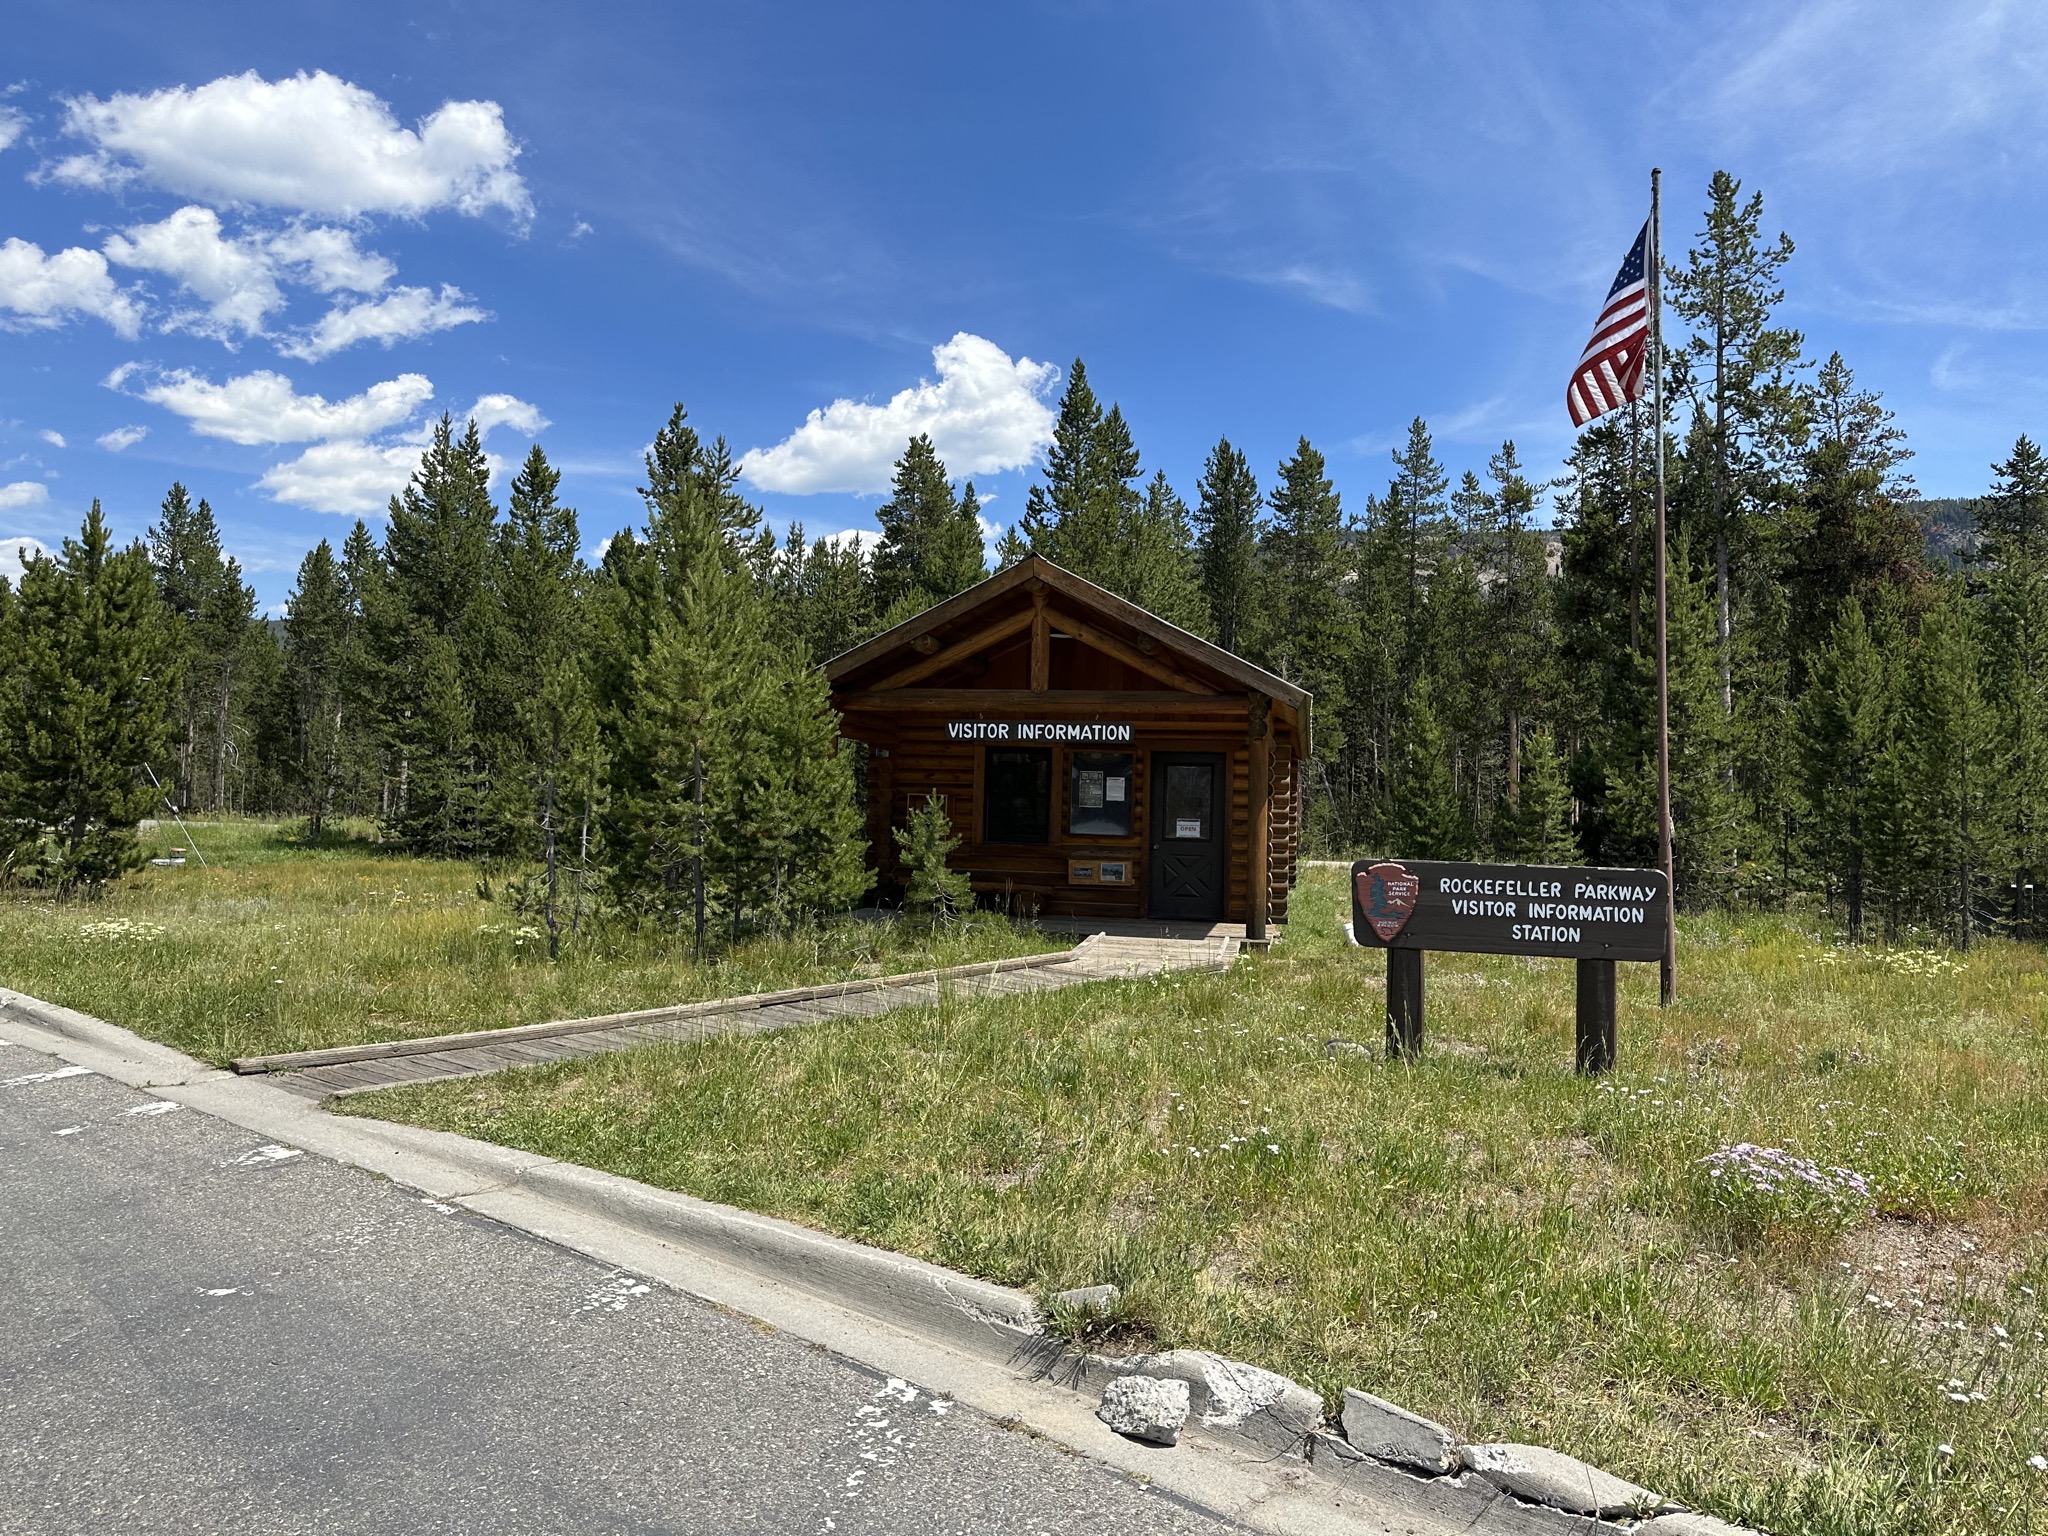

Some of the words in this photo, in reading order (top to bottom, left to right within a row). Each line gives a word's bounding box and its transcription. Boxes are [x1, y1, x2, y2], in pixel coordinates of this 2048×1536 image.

[949, 723, 1009, 739] VISITOR
[1017, 723, 1130, 741] INFORMATION
[1440, 877, 1561, 898] ROCKEFELLER
[1574, 883, 1657, 902] PARKWAY
[1451, 899, 1516, 918] VISITOR
[1528, 902, 1644, 923] INFORMATION
[1512, 924, 1581, 943] STATION
